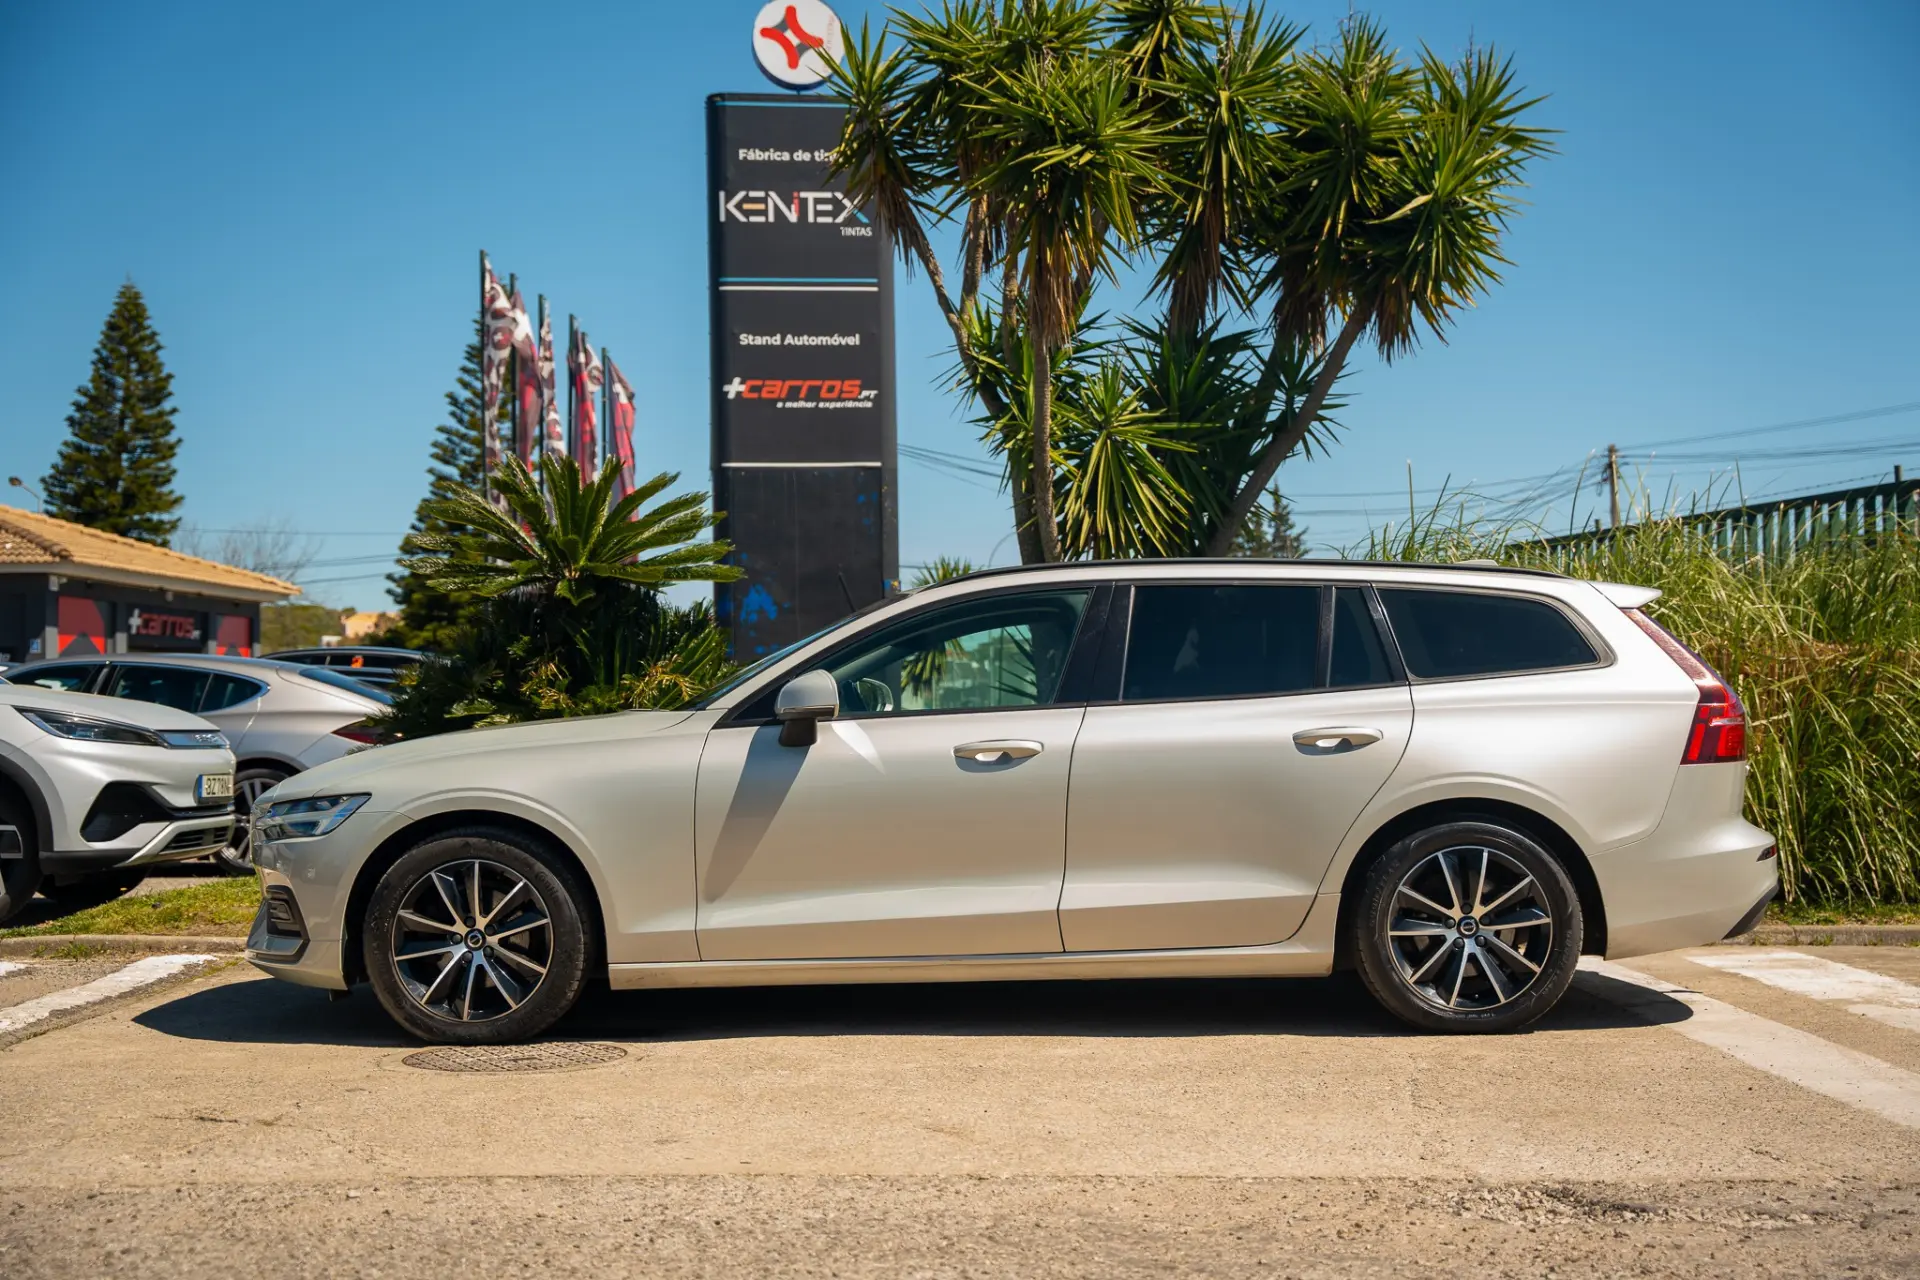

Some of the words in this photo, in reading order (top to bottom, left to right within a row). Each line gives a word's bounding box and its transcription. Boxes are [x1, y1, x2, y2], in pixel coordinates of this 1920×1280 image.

[738, 148, 791, 161] Fábrica
[793, 149, 812, 162] de
[840, 227, 873, 237] TINTAS
[739, 333, 781, 346] Stand
[784, 333, 860, 346] Automóvel
